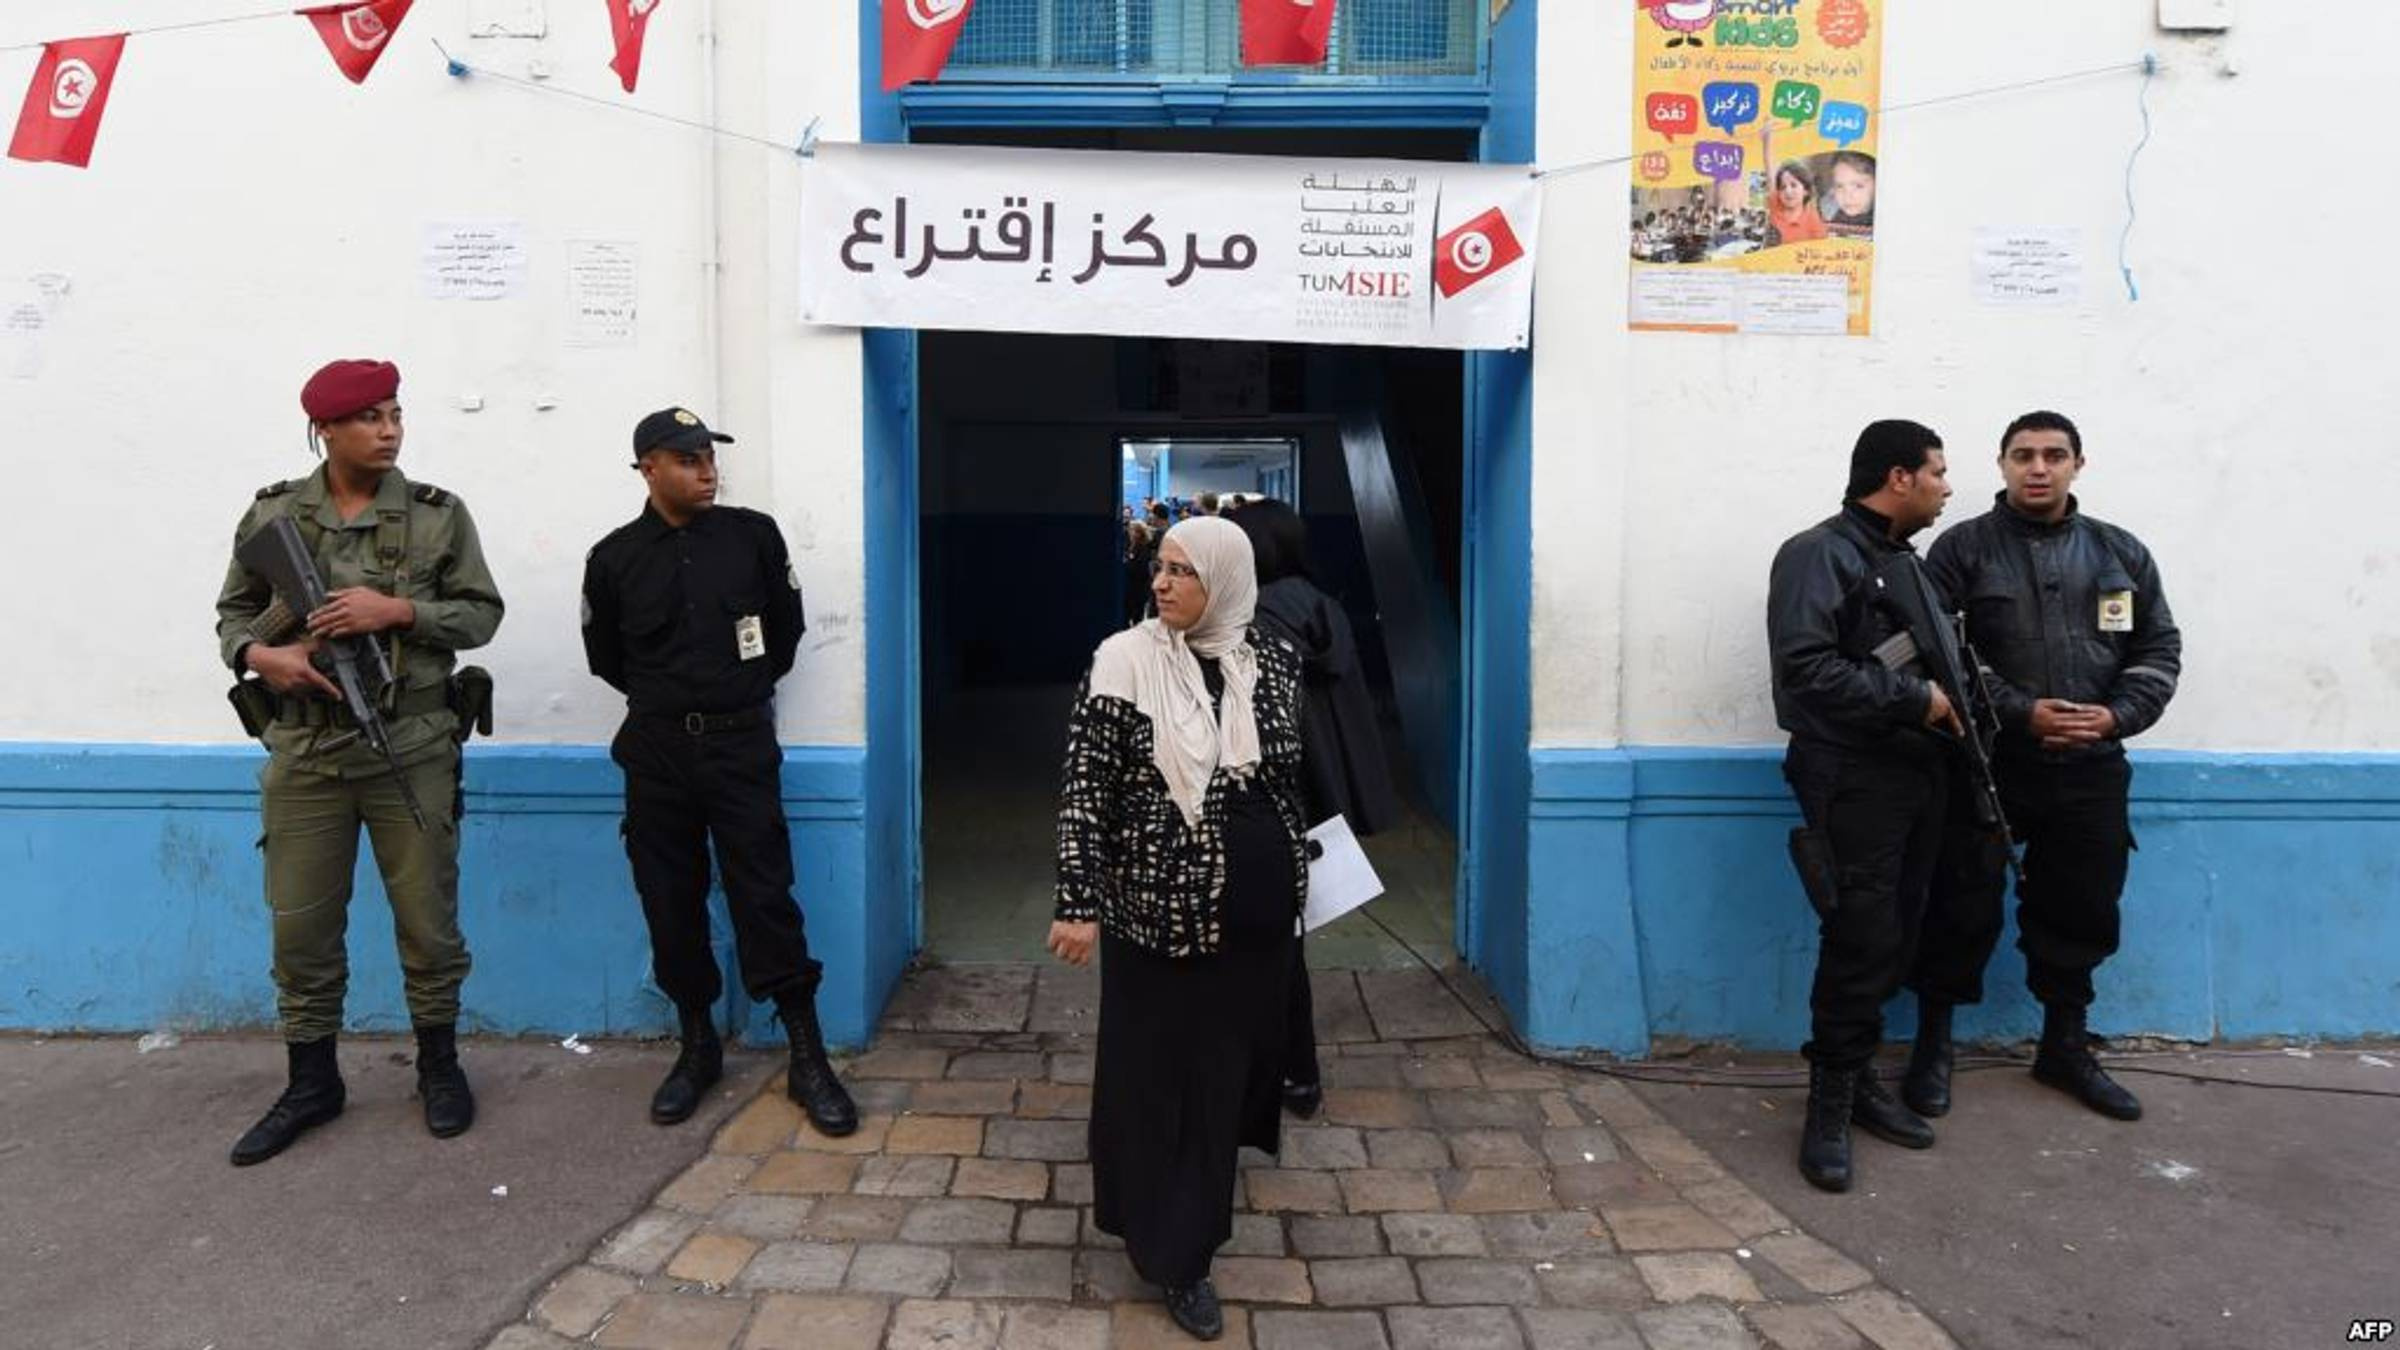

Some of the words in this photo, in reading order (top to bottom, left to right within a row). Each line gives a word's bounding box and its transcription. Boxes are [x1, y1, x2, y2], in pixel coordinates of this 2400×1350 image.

[1711, 90, 1751, 116] تركيز
[1301, 195, 1415, 216] العليا
[840, 196, 1056, 282] إقتراع
[1073, 211, 1258, 287] مركز
